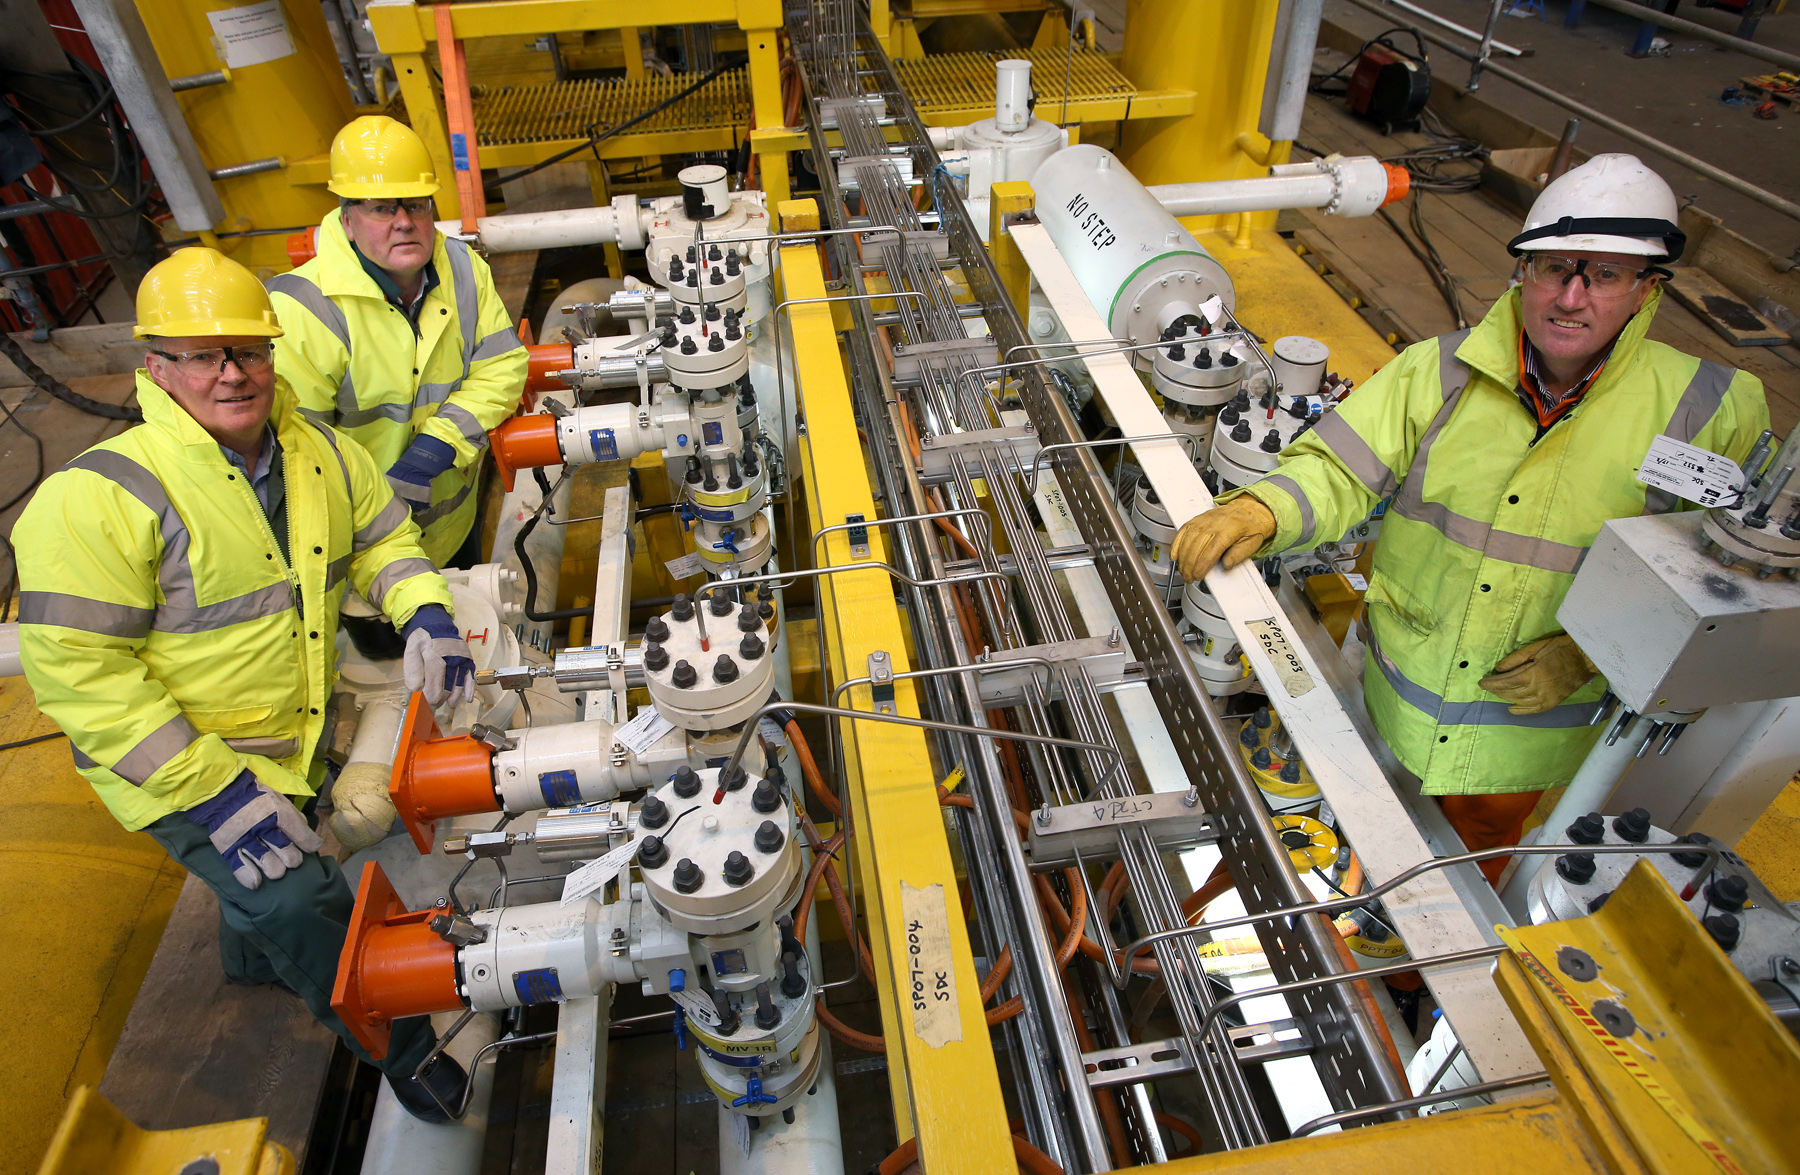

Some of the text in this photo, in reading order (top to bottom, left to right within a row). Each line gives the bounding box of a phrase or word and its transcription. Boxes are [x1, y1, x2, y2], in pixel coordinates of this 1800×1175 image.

[1066, 193, 1116, 252] NO STEP
[1258, 632, 1278, 656] SDC
[1360, 944, 1389, 954] PPTT
[934, 971, 950, 1002] SDC
